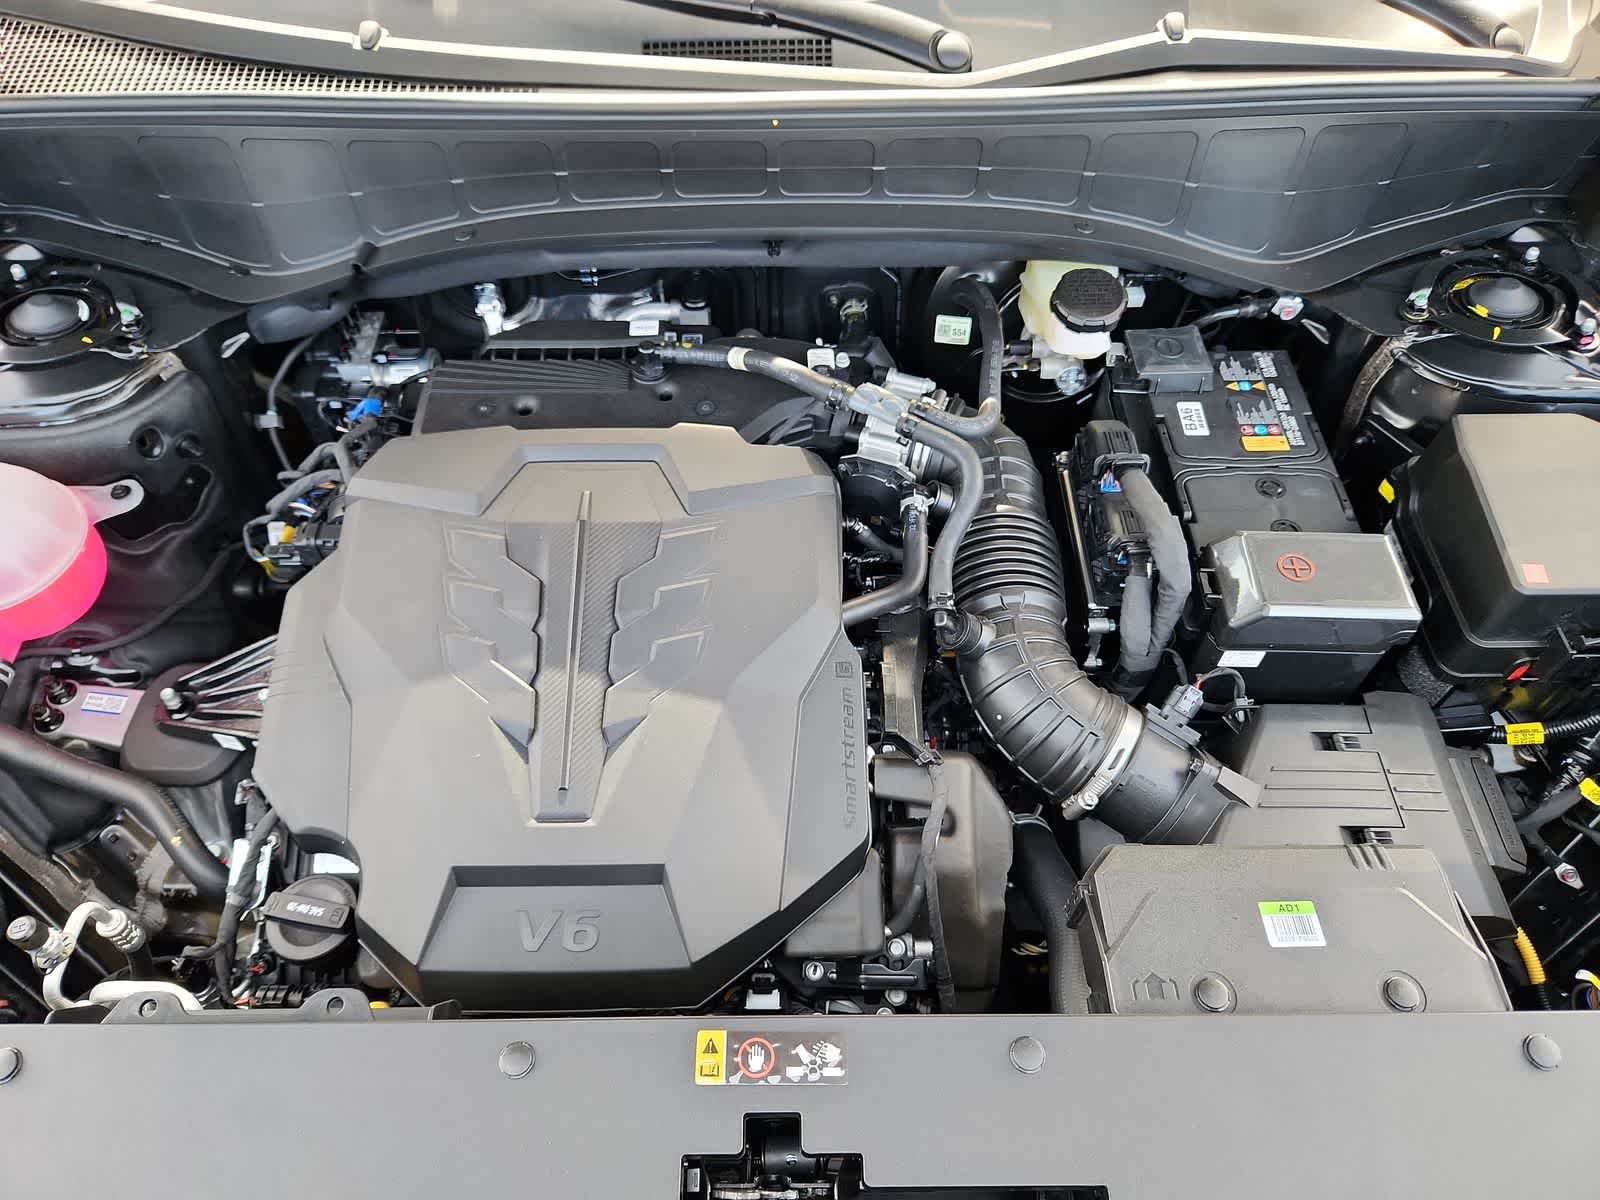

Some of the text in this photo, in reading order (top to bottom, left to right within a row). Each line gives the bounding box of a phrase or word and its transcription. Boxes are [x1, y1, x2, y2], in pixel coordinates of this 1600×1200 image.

[1179, 406, 1198, 432] BA6
[1278, 903, 1301, 913] AD1
[514, 908, 602, 953] V6
